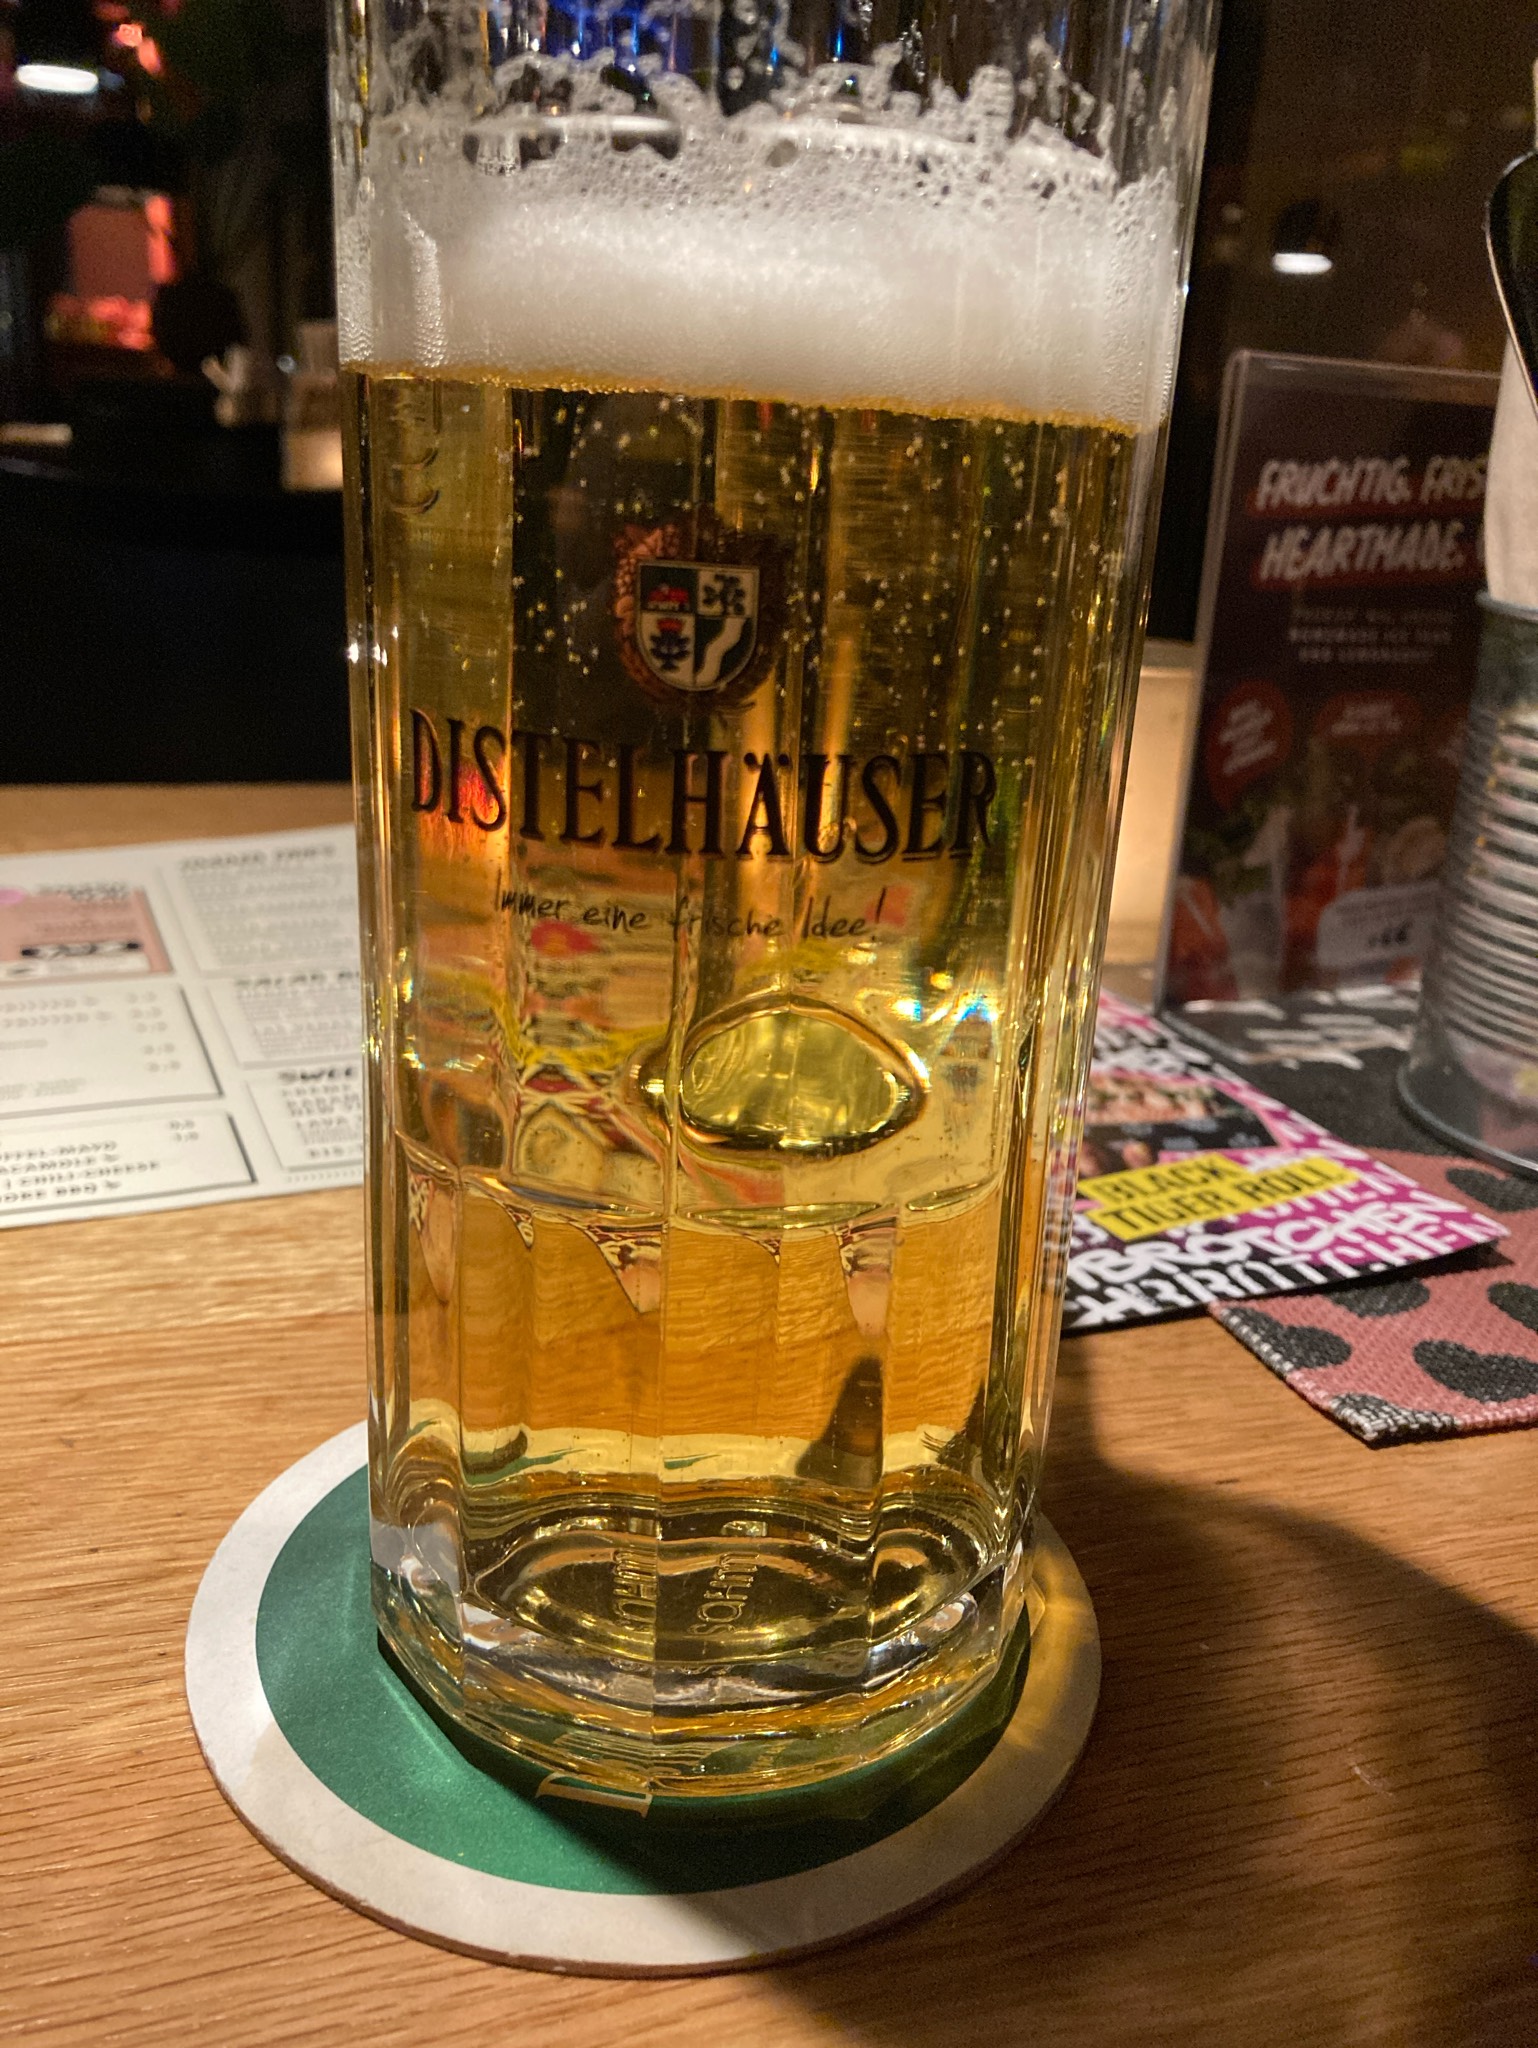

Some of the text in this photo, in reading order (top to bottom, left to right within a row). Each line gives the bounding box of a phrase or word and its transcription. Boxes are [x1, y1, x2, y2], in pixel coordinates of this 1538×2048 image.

[410, 706, 998, 866] DISTELHÄUSER
[583, 904, 650, 934] eine
[802, 885, 888, 941] Idee!
[1098, 1158, 1236, 1202] BLACK
[1100, 1190, 1236, 1233] TIGER
[1234, 1160, 1345, 1204] ROLL
